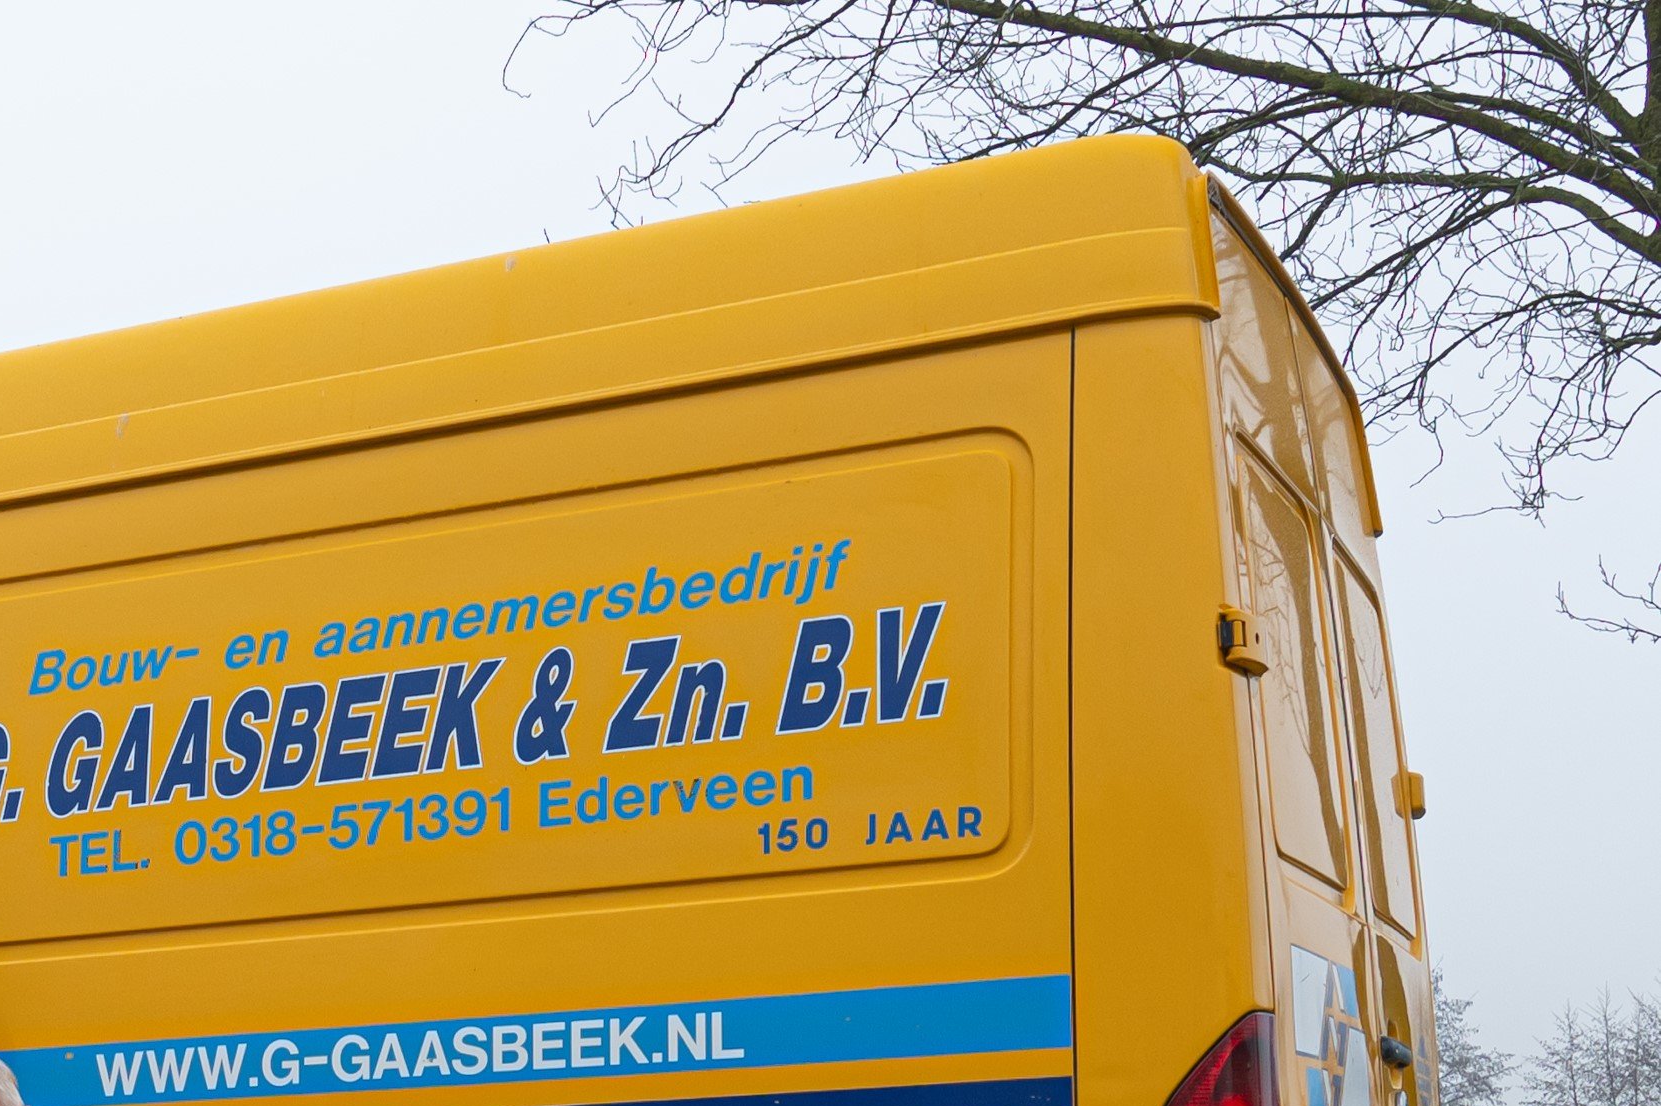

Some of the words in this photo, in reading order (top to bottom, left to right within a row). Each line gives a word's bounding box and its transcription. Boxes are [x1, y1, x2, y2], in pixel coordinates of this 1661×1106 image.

[28, 646, 200, 696] Bouw-
[224, 629, 289, 670] en
[313, 538, 852, 658] aannemersbedrijf
[44, 655, 507, 819] GAASBEEK
[512, 645, 578, 767] &
[601, 633, 750, 754] Zn.
[774, 600, 949, 736] B.V.
[50, 829, 151, 878] TEL.
[174, 787, 511, 866] 0318-571391
[539, 764, 815, 830] Ederveen
[757, 817, 830, 855] 150
[865, 805, 984, 846] JAAR
[95, 1011, 746, 1098] WWW.G-GAASBEEK.NL
